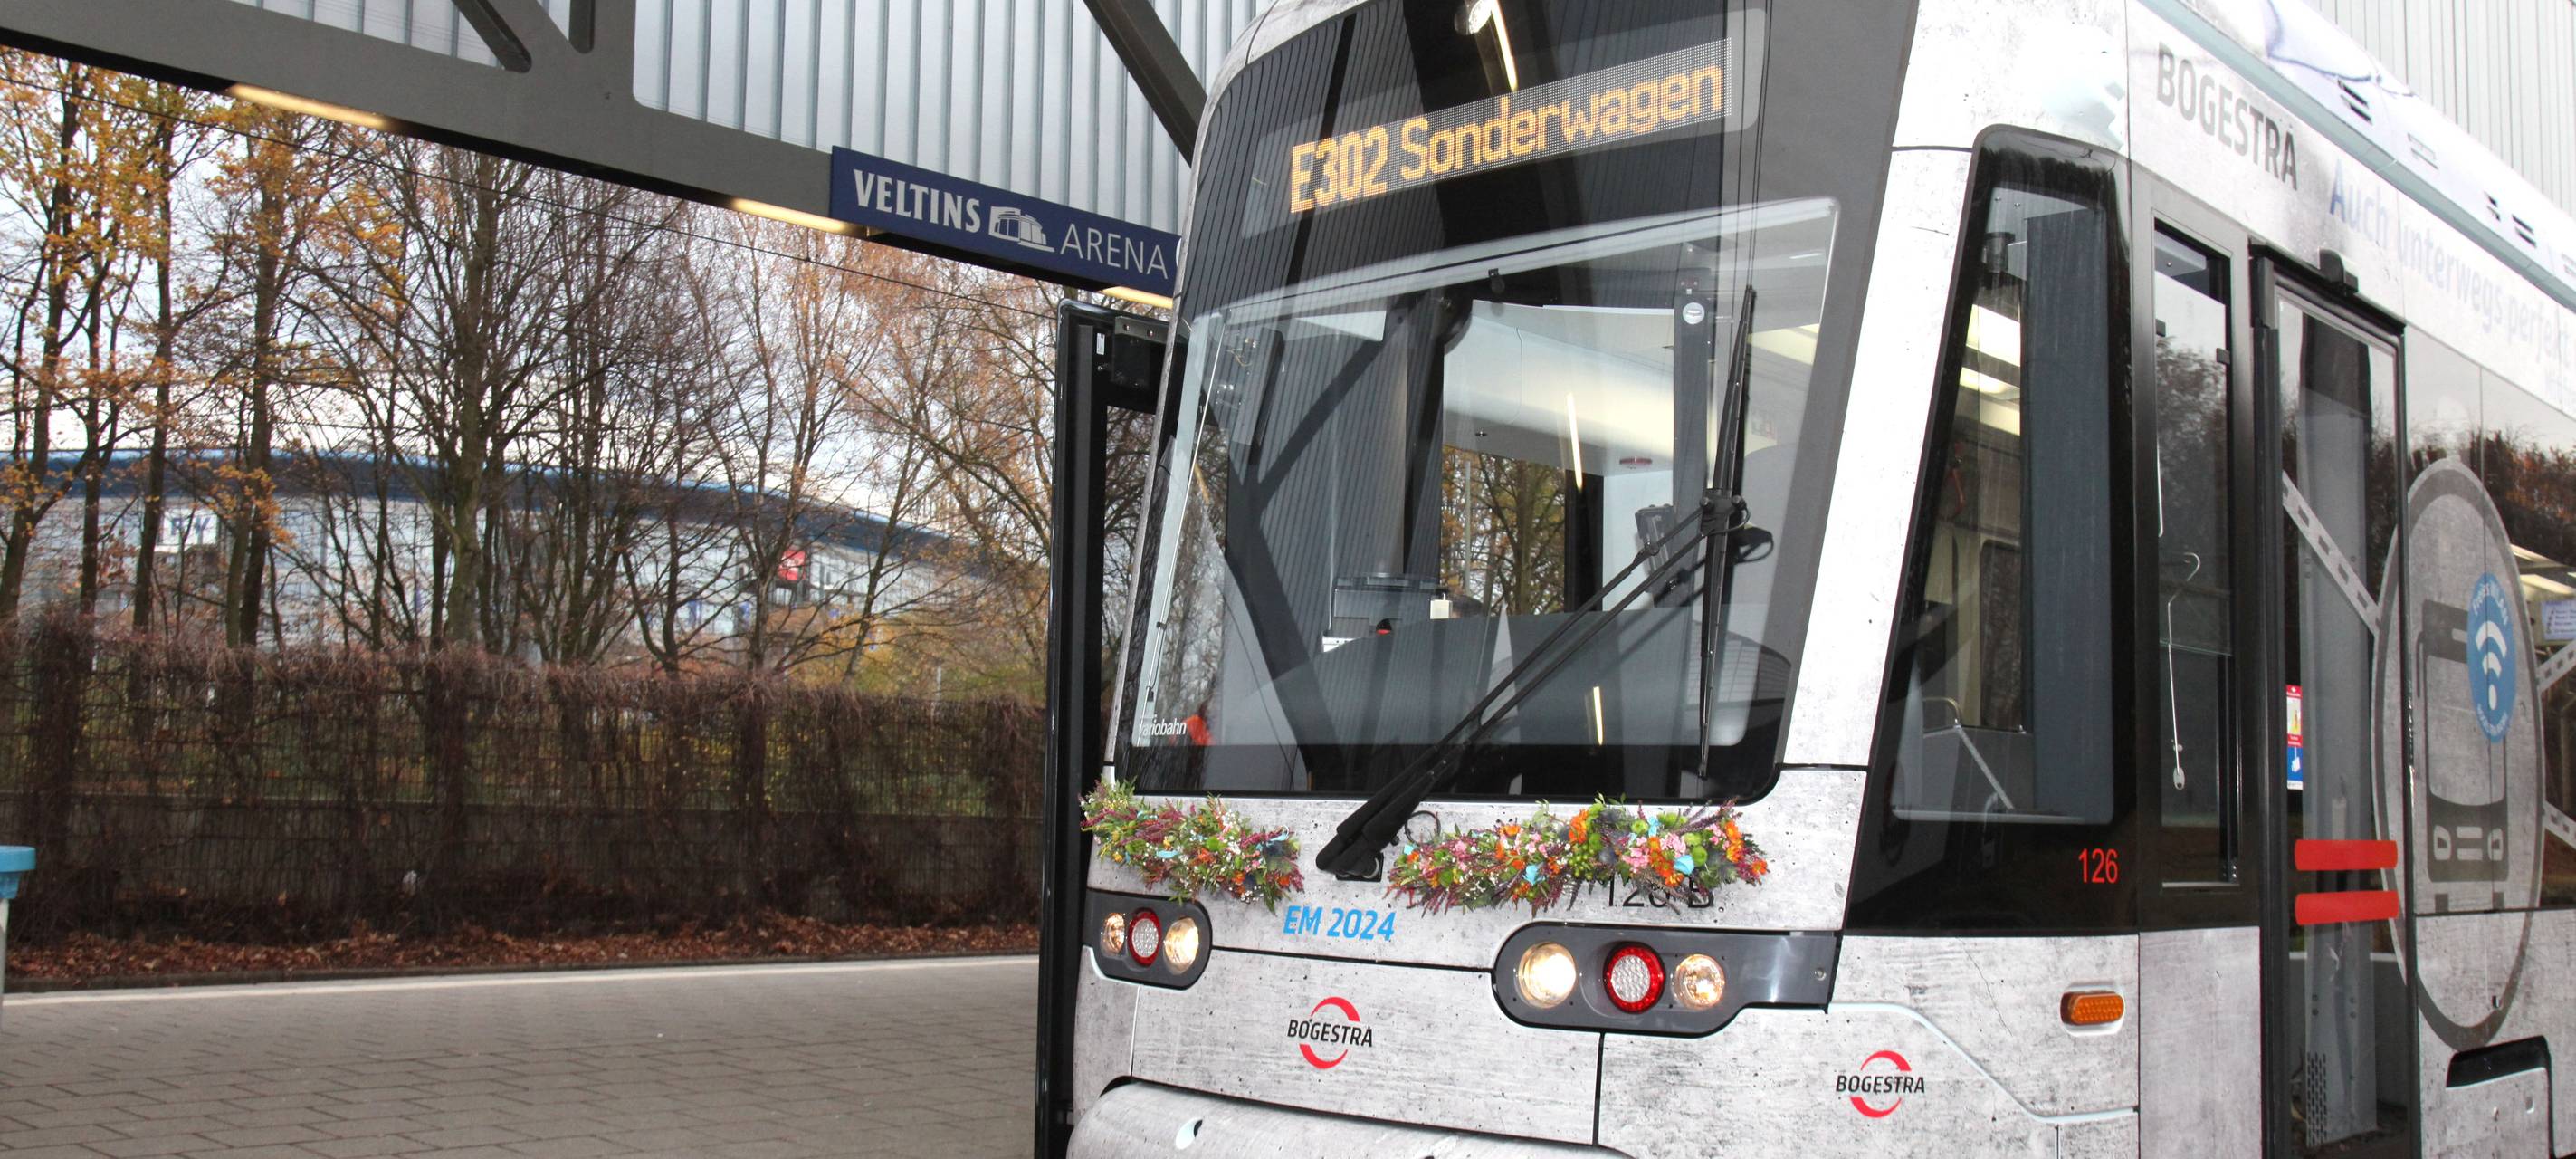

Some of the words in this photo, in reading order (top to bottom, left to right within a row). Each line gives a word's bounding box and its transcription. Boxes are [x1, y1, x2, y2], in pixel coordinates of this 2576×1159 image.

[1290, 126, 1388, 213] E302
[1400, 64, 1723, 181] Sonderwagen
[2157, 43, 2298, 190] BOGESTRA
[853, 168, 981, 234] VELTINS
[1060, 223, 1169, 280] ARENA
[2329, 156, 2389, 249] Auch
[2397, 225, 2504, 335] unterwegs
[2078, 848, 2119, 884] 126
[1283, 905, 1323, 935] EM
[1327, 908, 1396, 942] 2024
[1287, 1019, 1373, 1048] BOGESTRA
[1836, 1075, 1925, 1094] BOGESTRA
